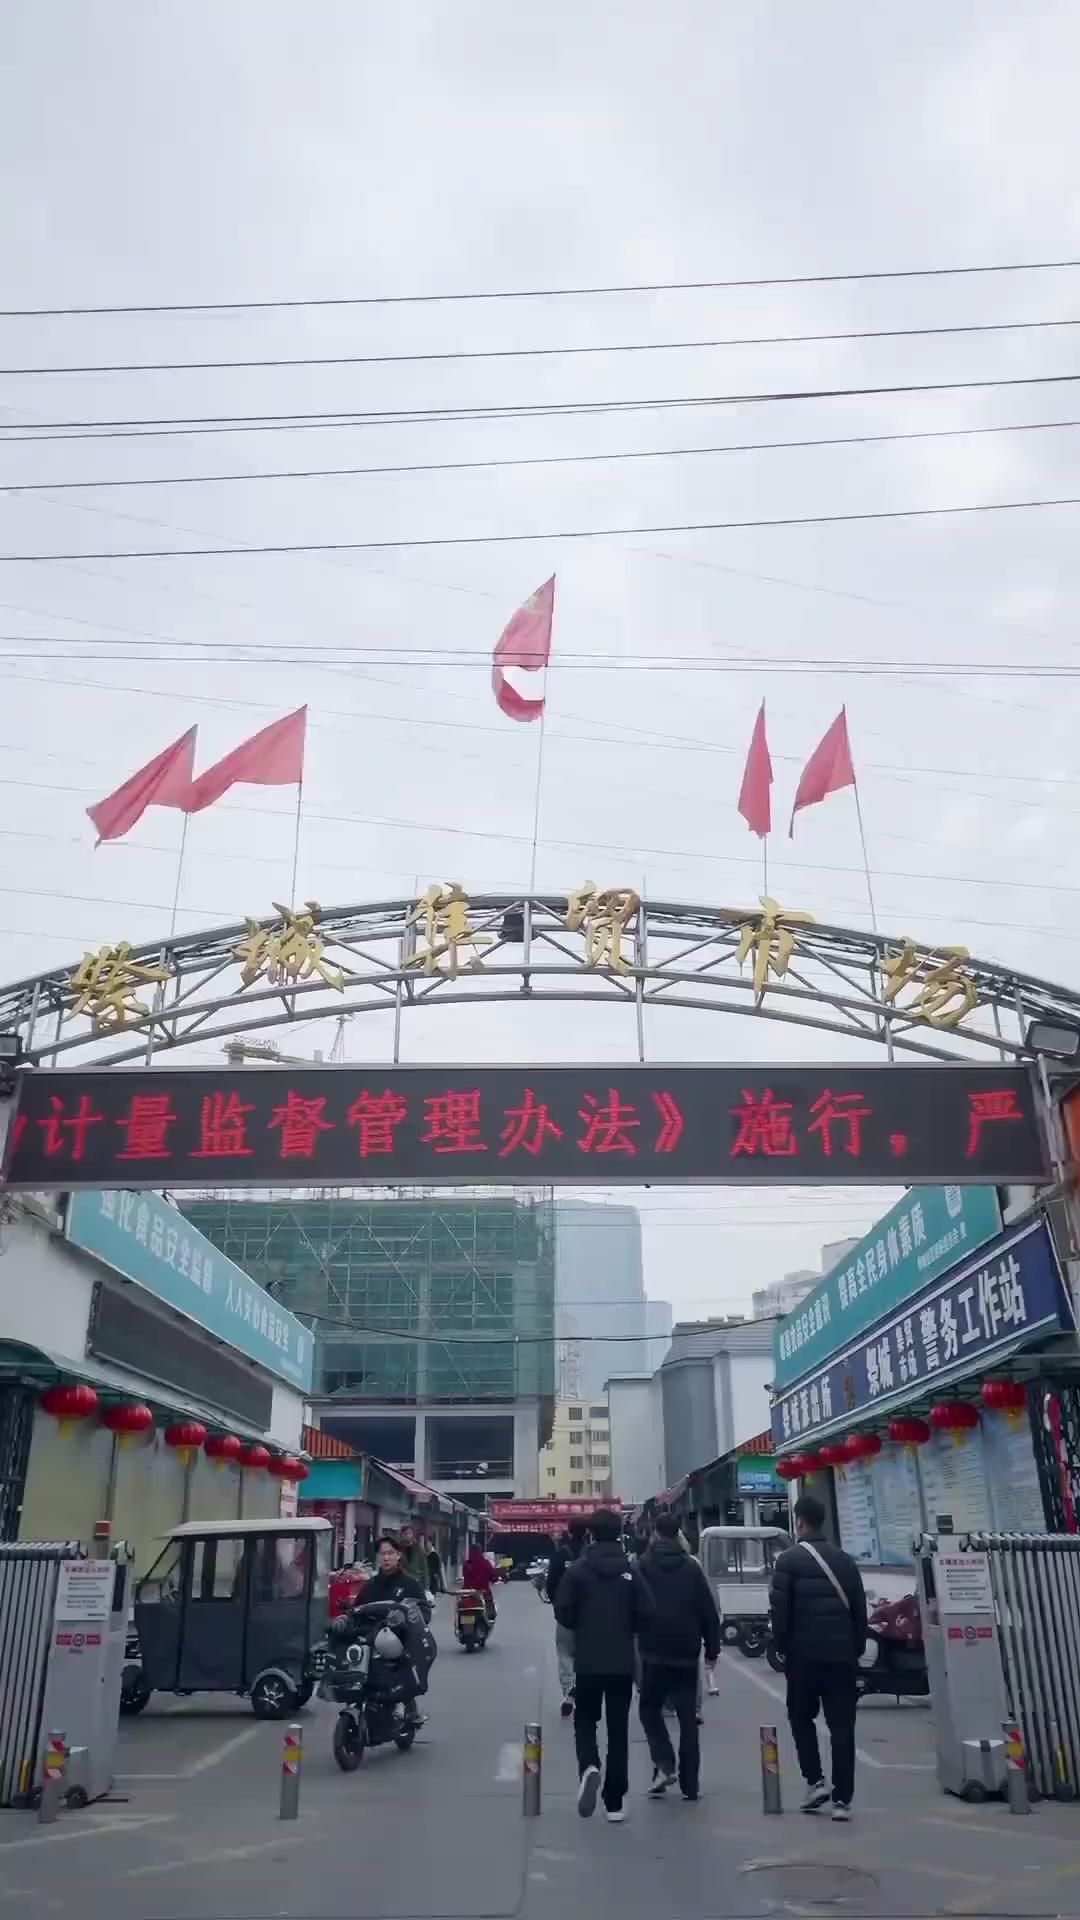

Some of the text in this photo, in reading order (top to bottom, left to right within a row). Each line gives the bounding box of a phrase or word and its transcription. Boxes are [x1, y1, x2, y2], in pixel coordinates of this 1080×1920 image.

[12, 1086, 1025, 1164] 计量监督管理办法》施行，严
[919, 1254, 1028, 1371] 警务工作站
